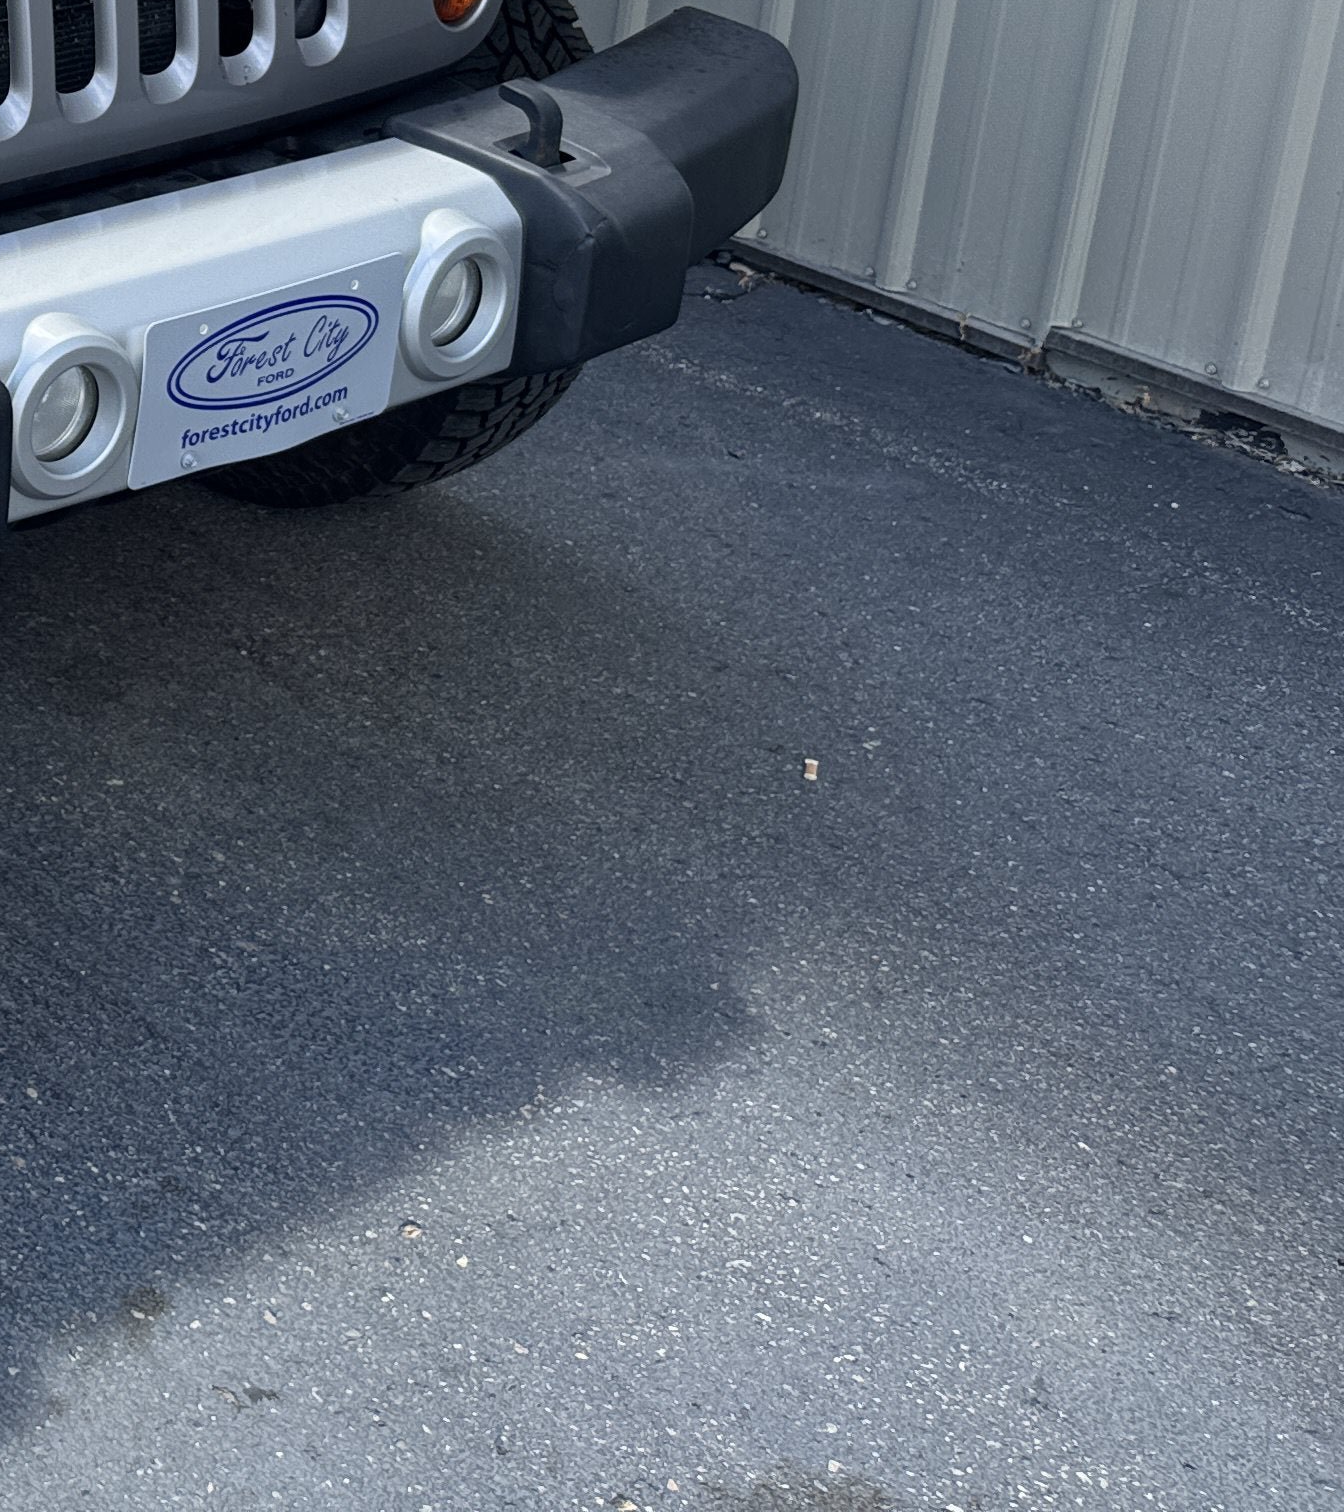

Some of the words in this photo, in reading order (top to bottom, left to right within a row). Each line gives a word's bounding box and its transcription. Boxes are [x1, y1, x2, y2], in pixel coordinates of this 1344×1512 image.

[206, 330, 296, 383] Forest
[303, 315, 350, 363] City
[257, 368, 295, 387] FORD
[181, 386, 348, 449] forestcityford.com
